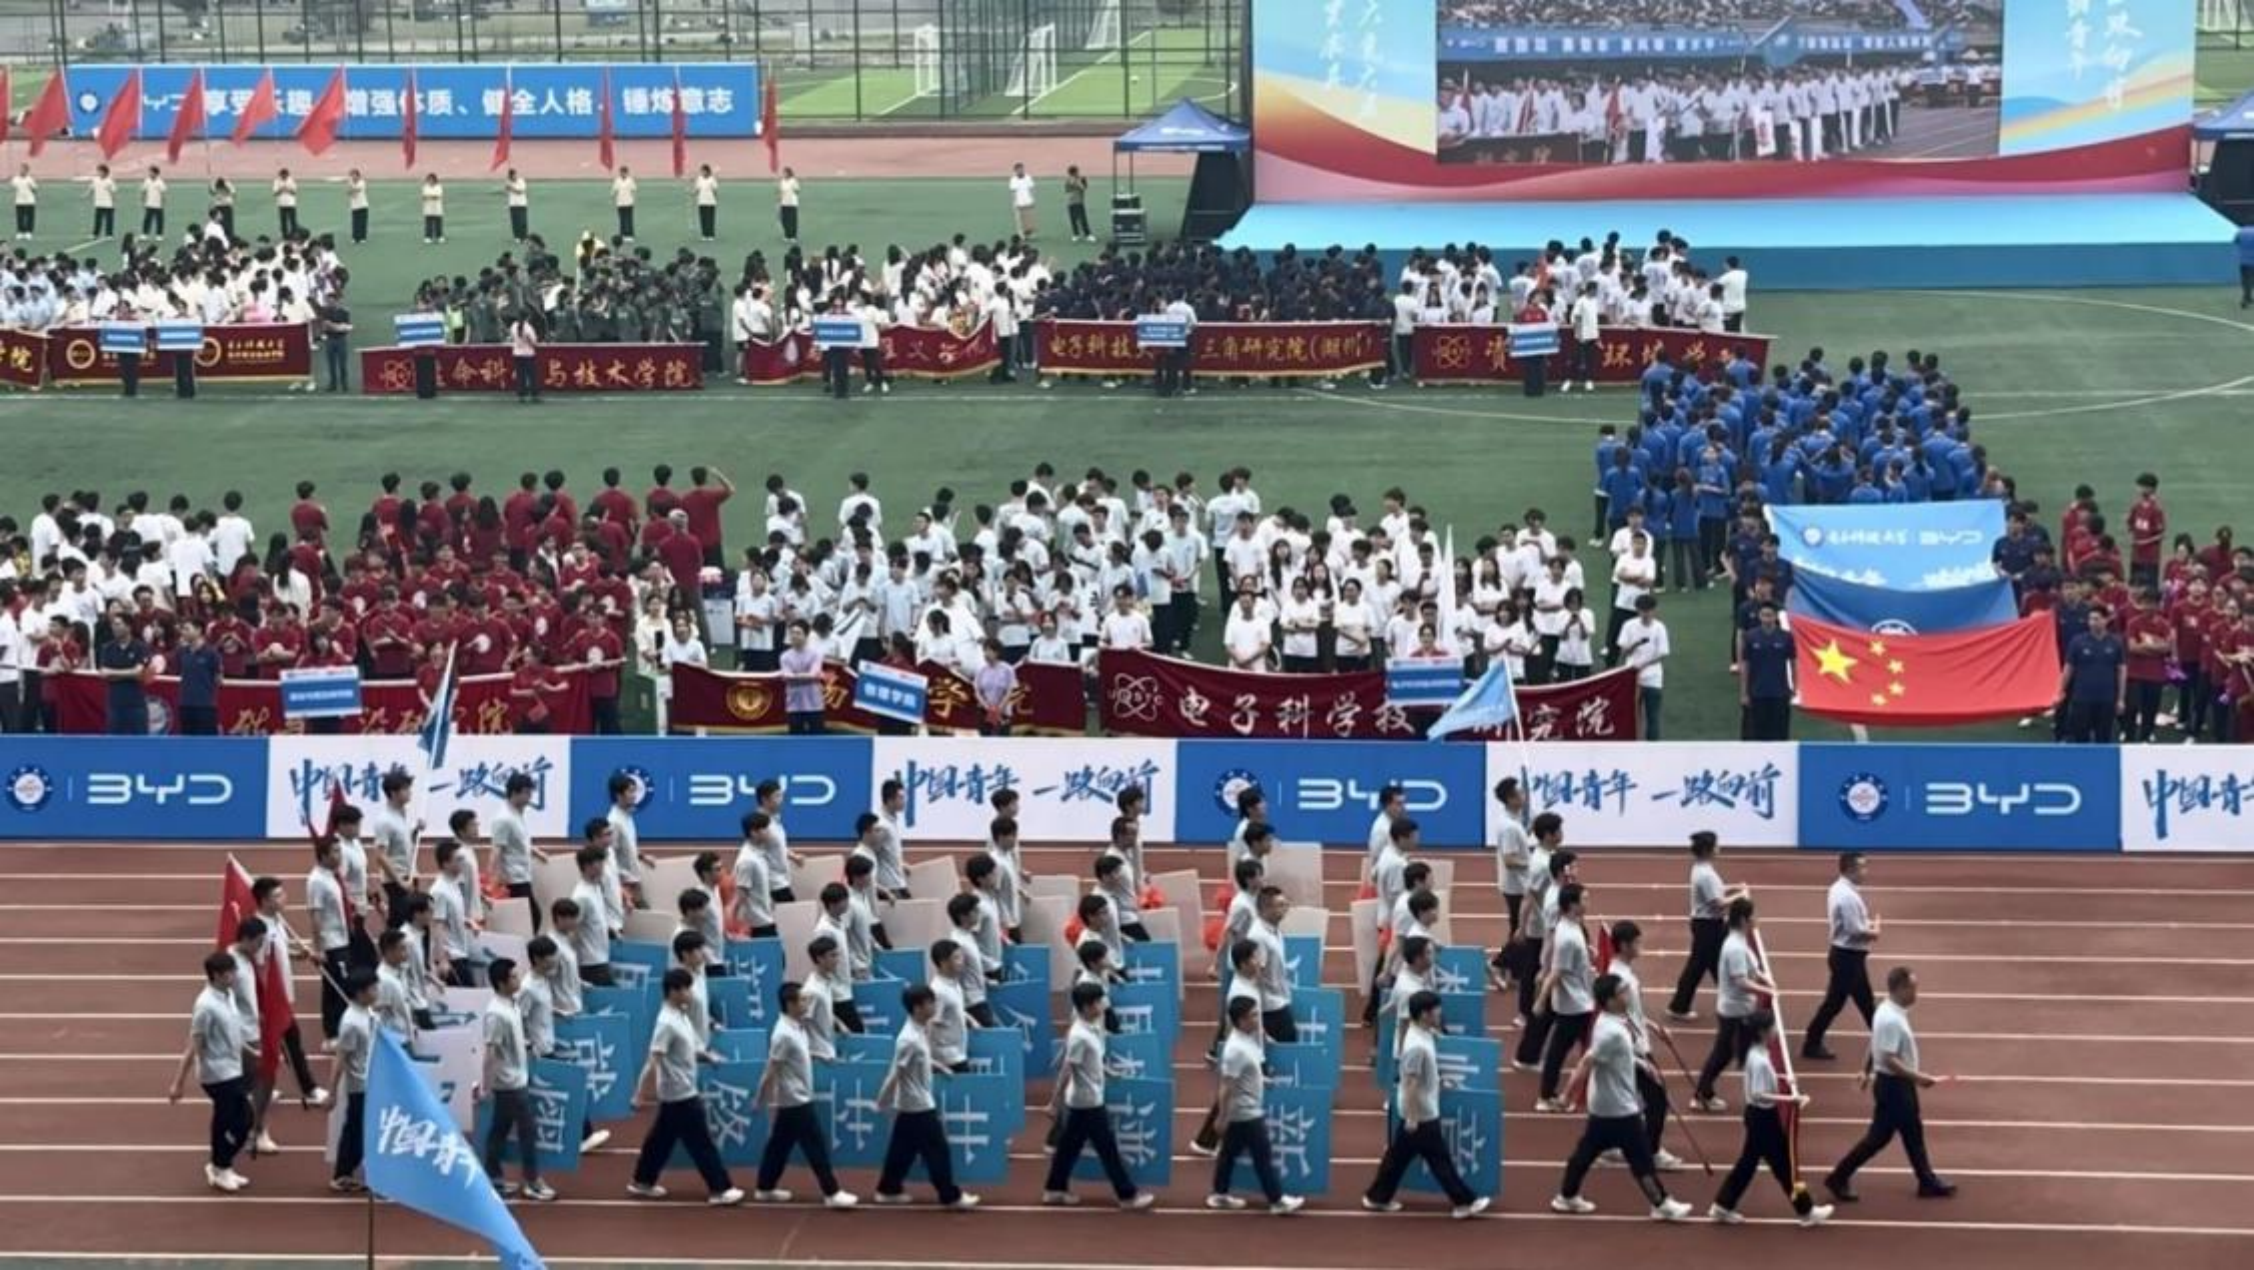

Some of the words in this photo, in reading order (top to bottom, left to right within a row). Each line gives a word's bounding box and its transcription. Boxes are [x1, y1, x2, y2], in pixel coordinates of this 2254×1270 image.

[88, 774, 233, 804] BYD
[1651, 761, 1781, 819] 一路向前
[1926, 783, 2082, 814] BYD
